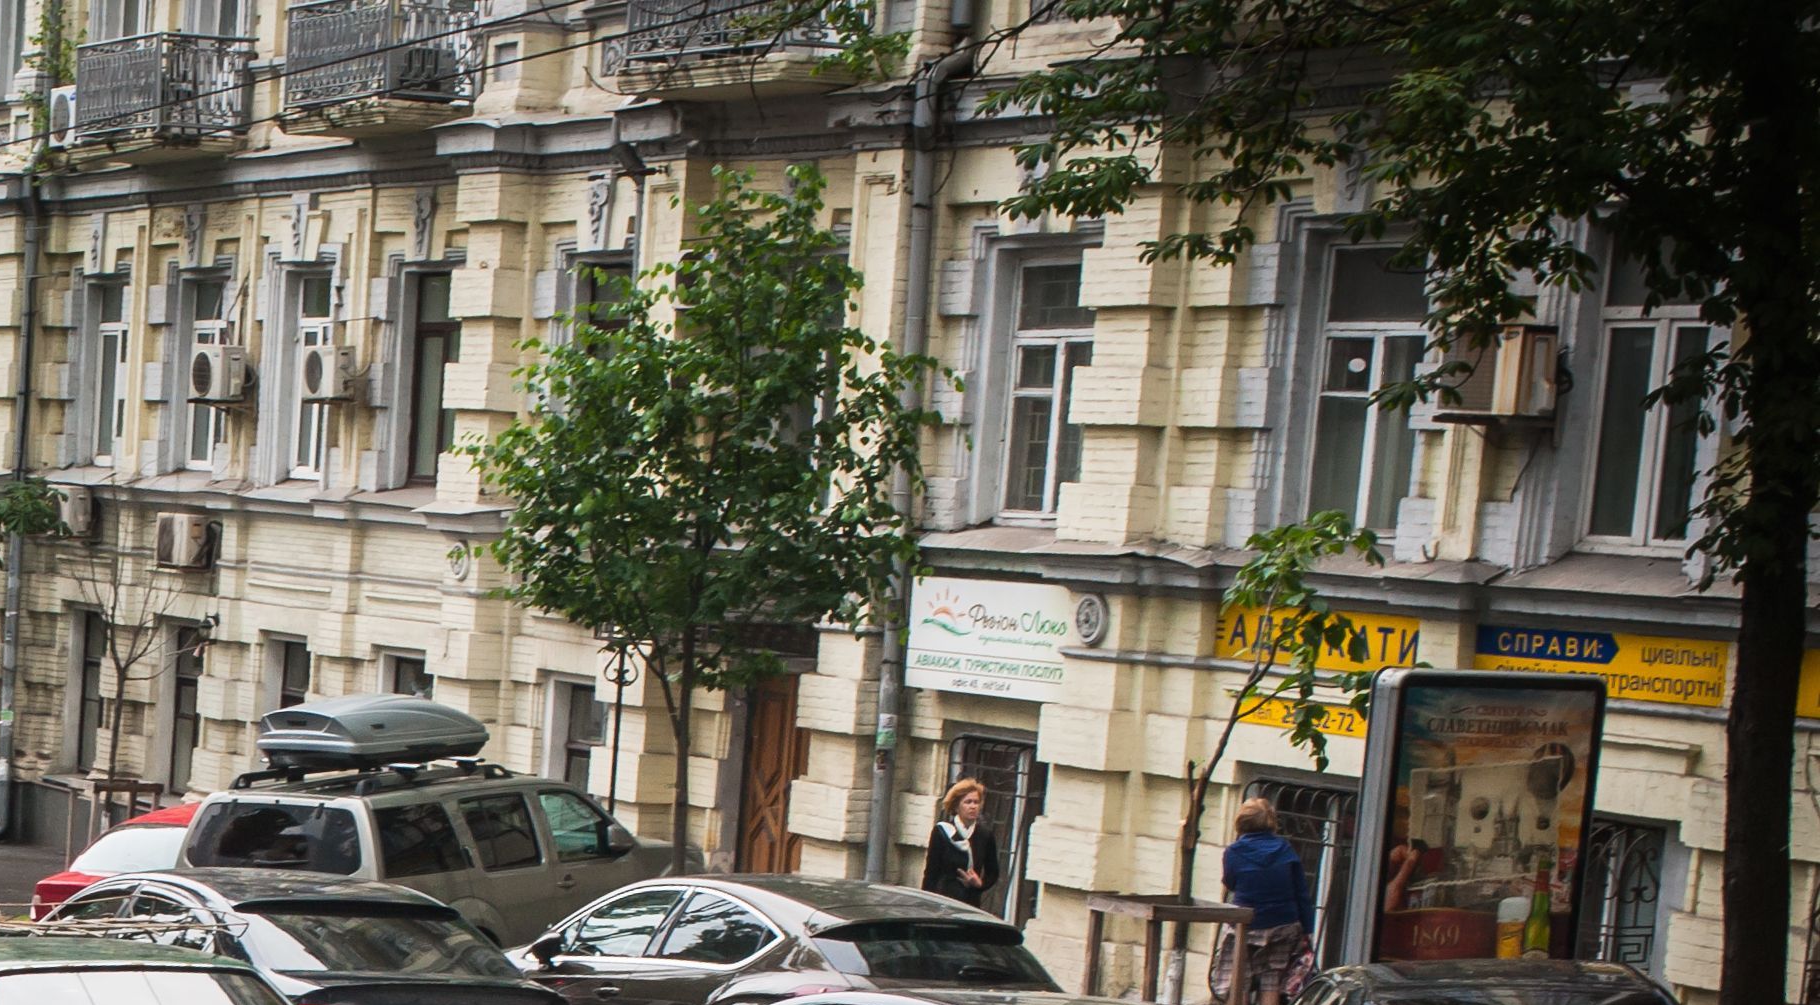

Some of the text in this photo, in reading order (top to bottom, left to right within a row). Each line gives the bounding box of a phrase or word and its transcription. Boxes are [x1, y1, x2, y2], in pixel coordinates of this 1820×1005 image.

[1229, 612, 1420, 665] АДВАТИ
[1497, 631, 1604, 659] СПРАВИ:
[1641, 644, 1723, 671] цивільні,
[1568, 670, 1723, 698] транспортні
